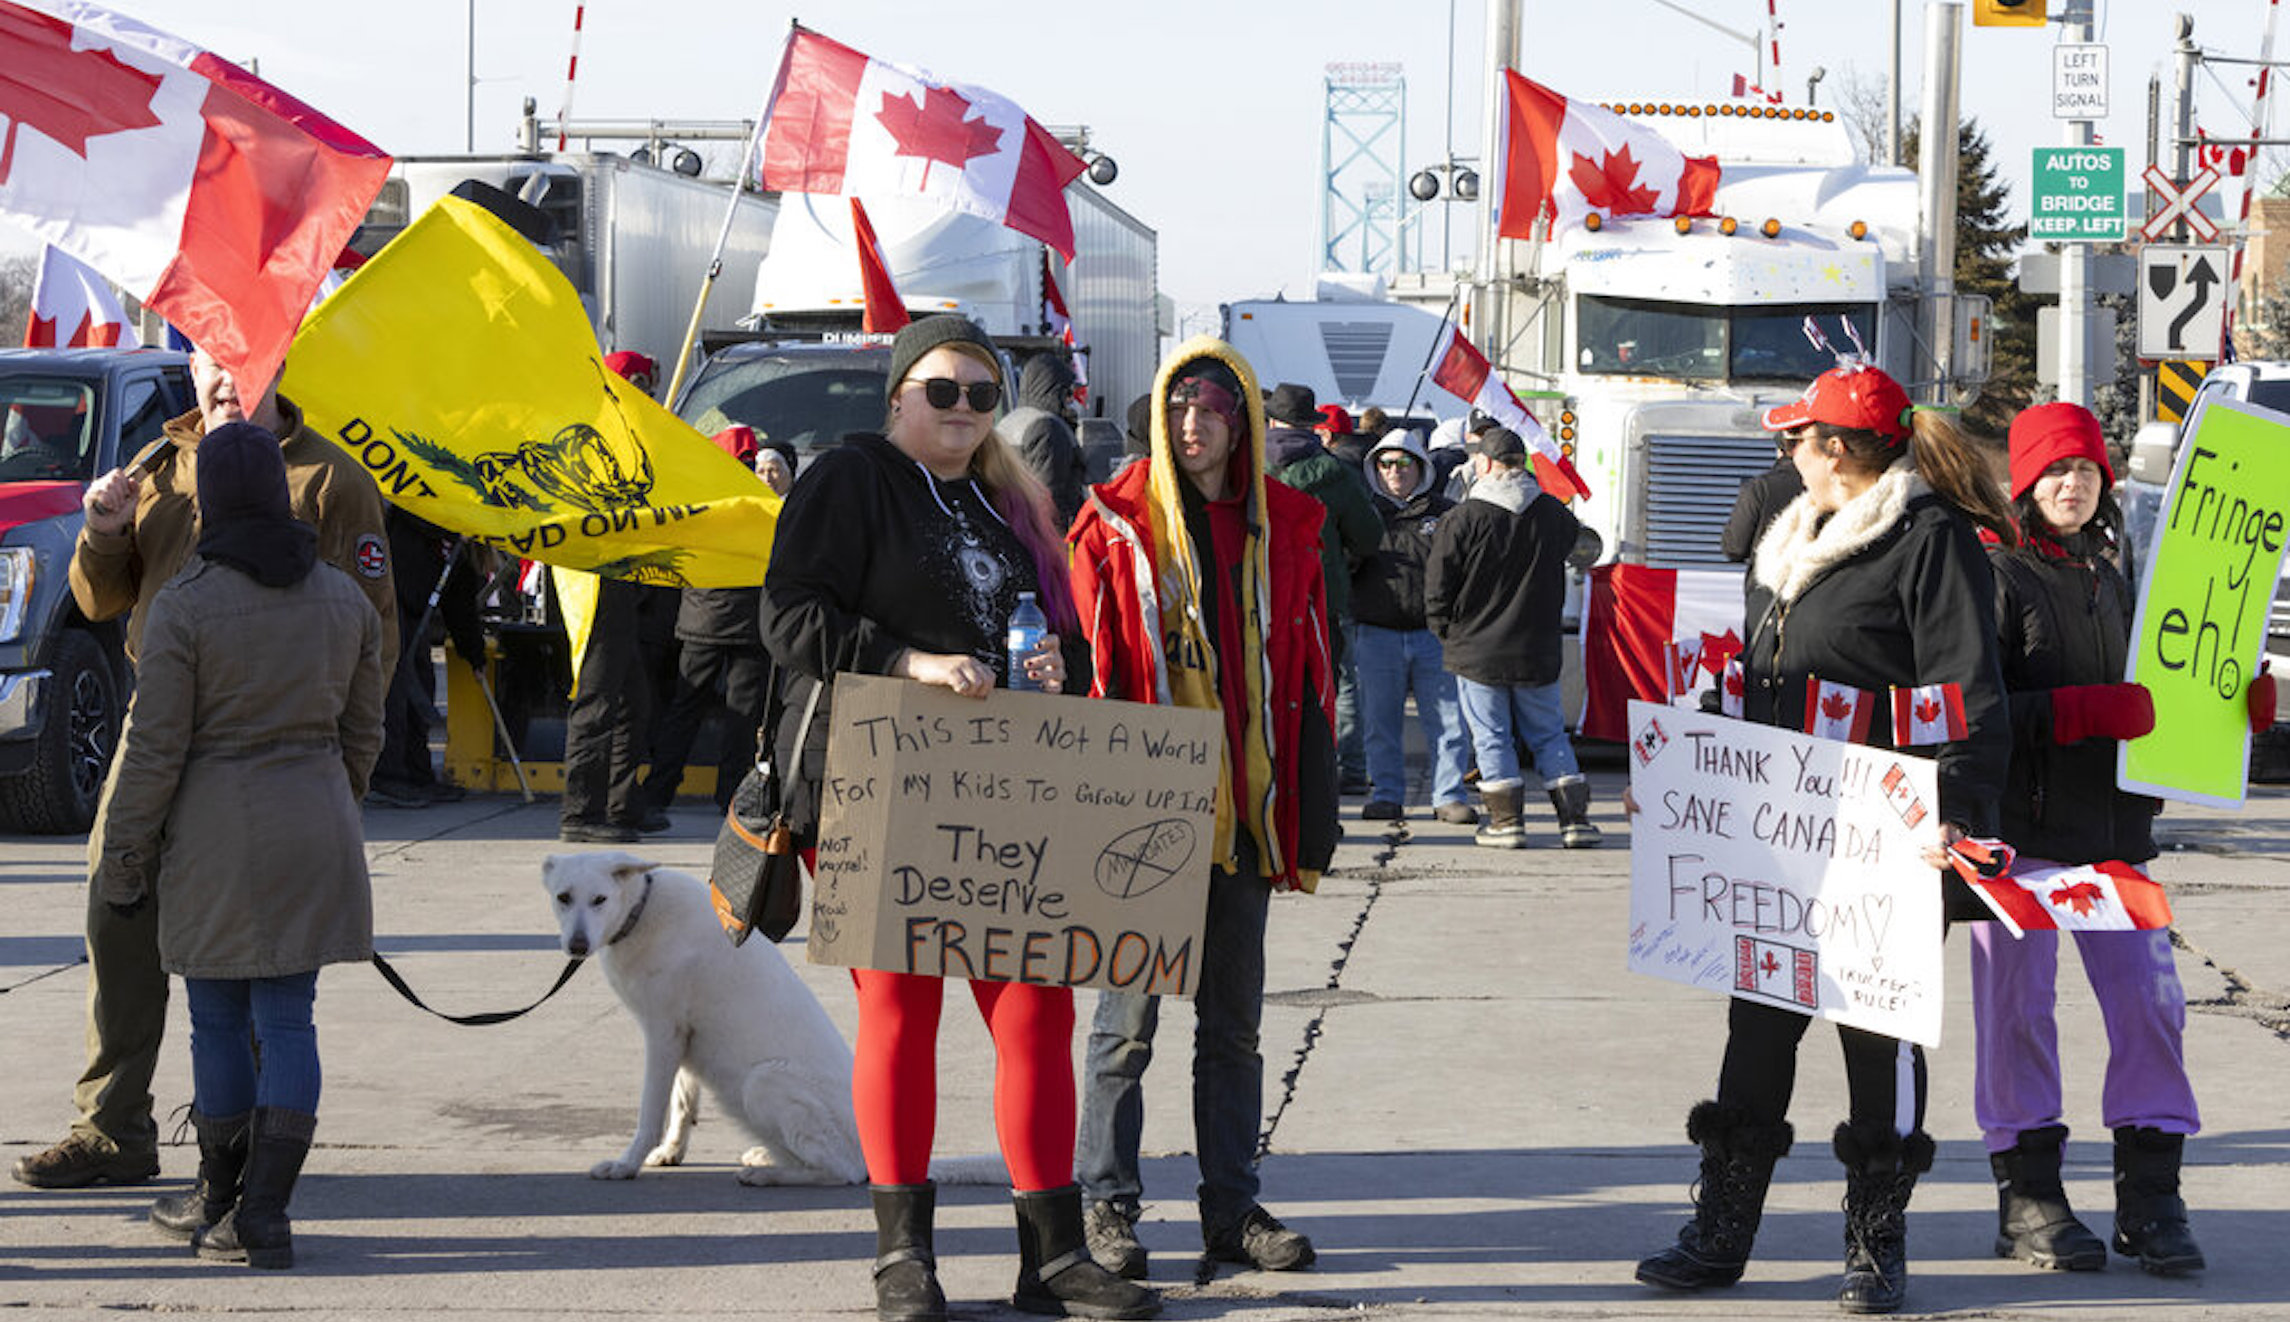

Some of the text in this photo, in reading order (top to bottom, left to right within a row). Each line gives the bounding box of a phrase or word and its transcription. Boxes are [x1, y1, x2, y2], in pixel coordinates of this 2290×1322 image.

[2063, 53, 2097, 68] LEFT
[2063, 73, 2099, 87] TURN
[2056, 93, 2105, 108] SIGNAL
[2045, 154, 2112, 172] AUTOS
[2068, 175, 2090, 189] TO
[2033, 217, 2123, 233] KEEP LEFT
[2040, 195, 2116, 212] BRIDGE
[338, 417, 438, 499] DONT
[2171, 446, 2284, 590] Fringe
[2156, 576, 2251, 700] eh!
[1108, 722, 1129, 753] A
[1140, 729, 1207, 765] World
[1683, 730, 1772, 785] THANK
[830, 776, 878, 805] For
[1659, 790, 1882, 864] SAVE CANADA
[936, 824, 1049, 884] They
[892, 865, 1070, 920] Deserve
[1667, 853, 1860, 949] FREEDOM
[905, 916, 1193, 997] FREEDOM
